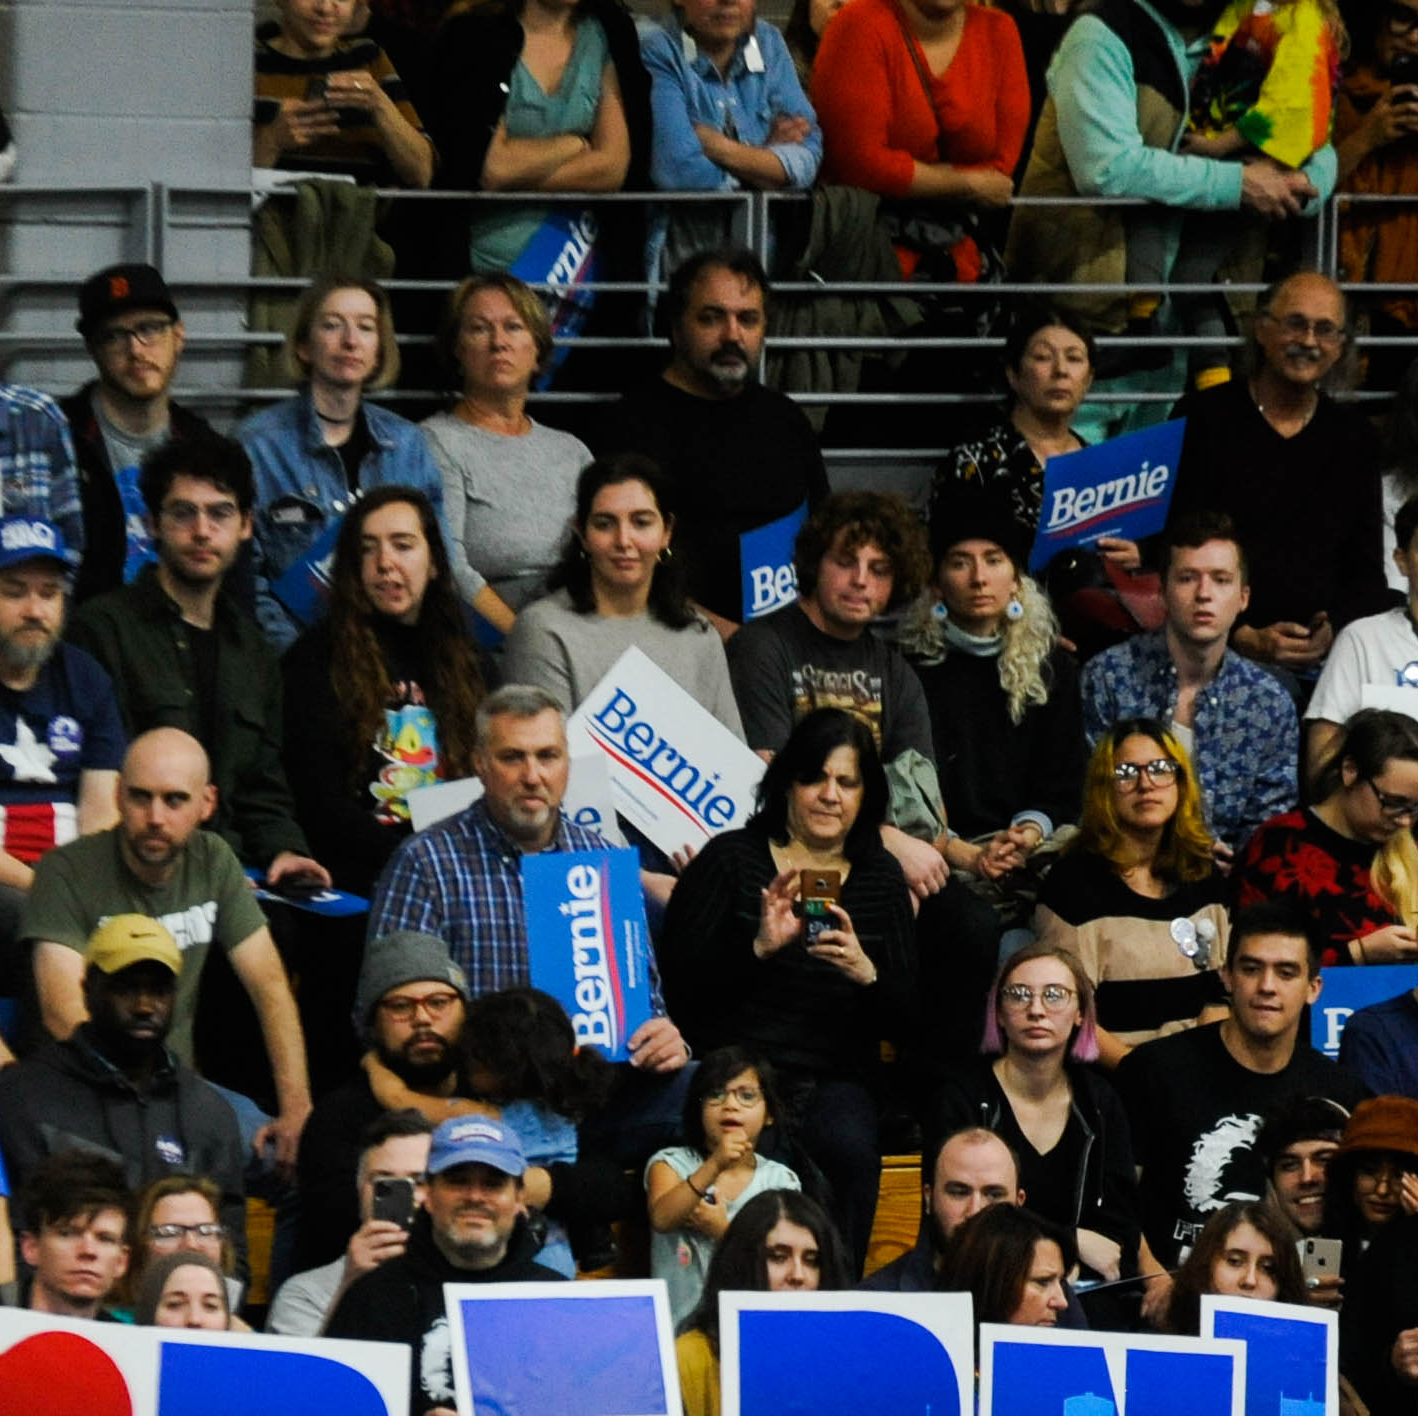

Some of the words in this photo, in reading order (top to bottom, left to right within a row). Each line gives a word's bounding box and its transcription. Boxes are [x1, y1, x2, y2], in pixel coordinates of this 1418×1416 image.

[545, 206, 598, 302] rnie
[1043, 458, 1167, 531] Bernie
[589, 686, 738, 833] Bernie
[572, 862, 613, 1048] Bernie
